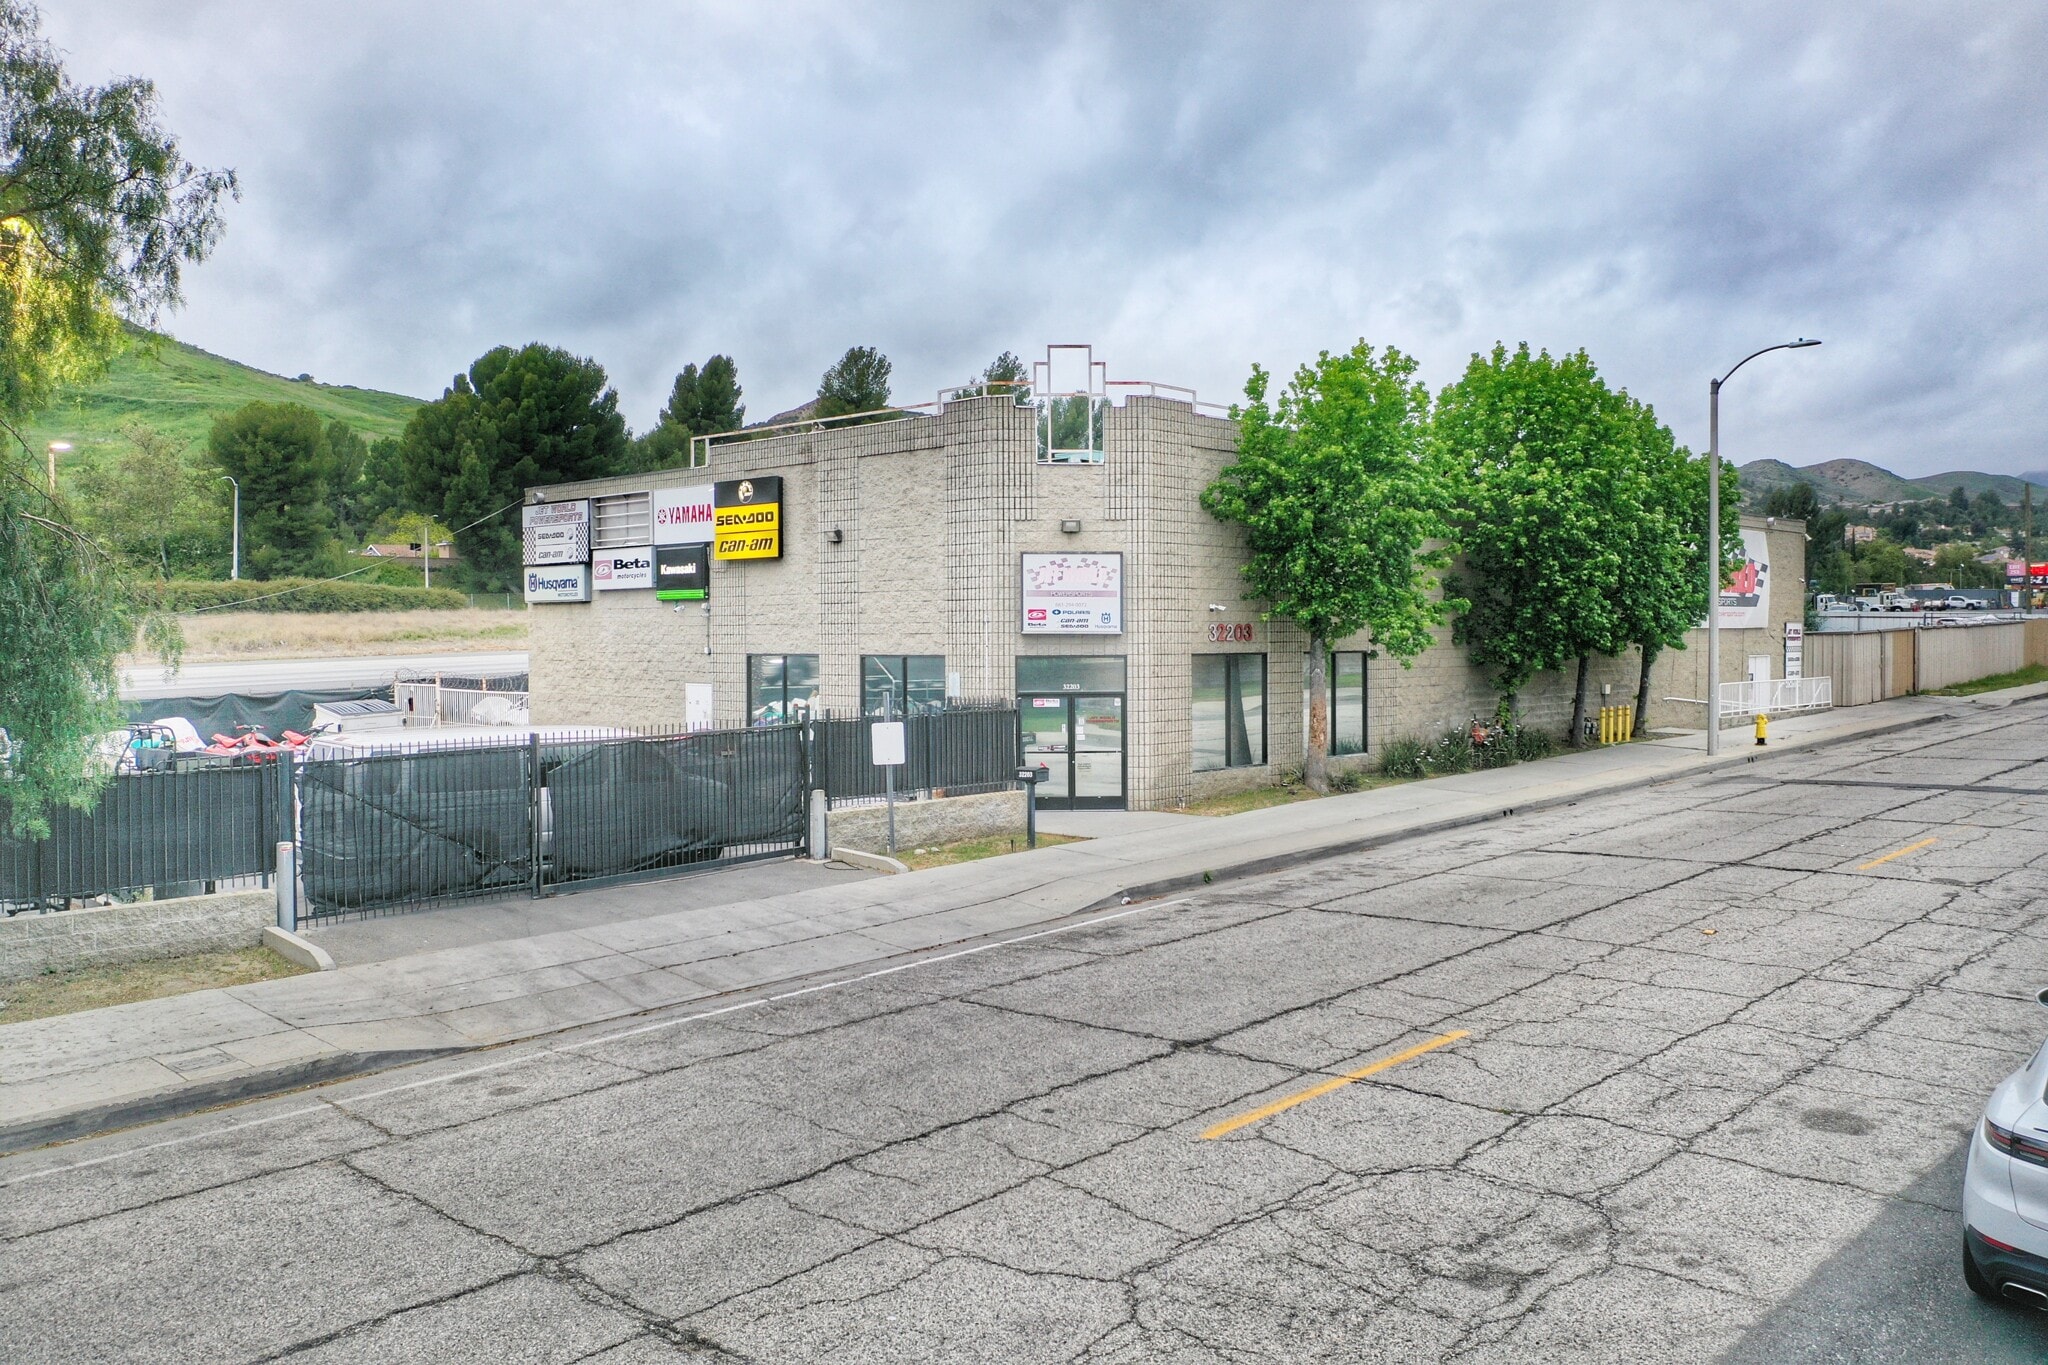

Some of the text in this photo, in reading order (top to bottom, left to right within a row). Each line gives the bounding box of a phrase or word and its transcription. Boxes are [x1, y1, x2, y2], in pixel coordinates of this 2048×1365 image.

[529, 512, 583, 525] POWERSPORTS
[668, 503, 713, 524] YAMAHA
[614, 558, 650, 570] Beta
[660, 562, 696, 575] Kawasaki
[617, 572, 647, 580] motorcycles
[538, 577, 578, 591] Husqvarna
[1208, 623, 1253, 642] 32203
